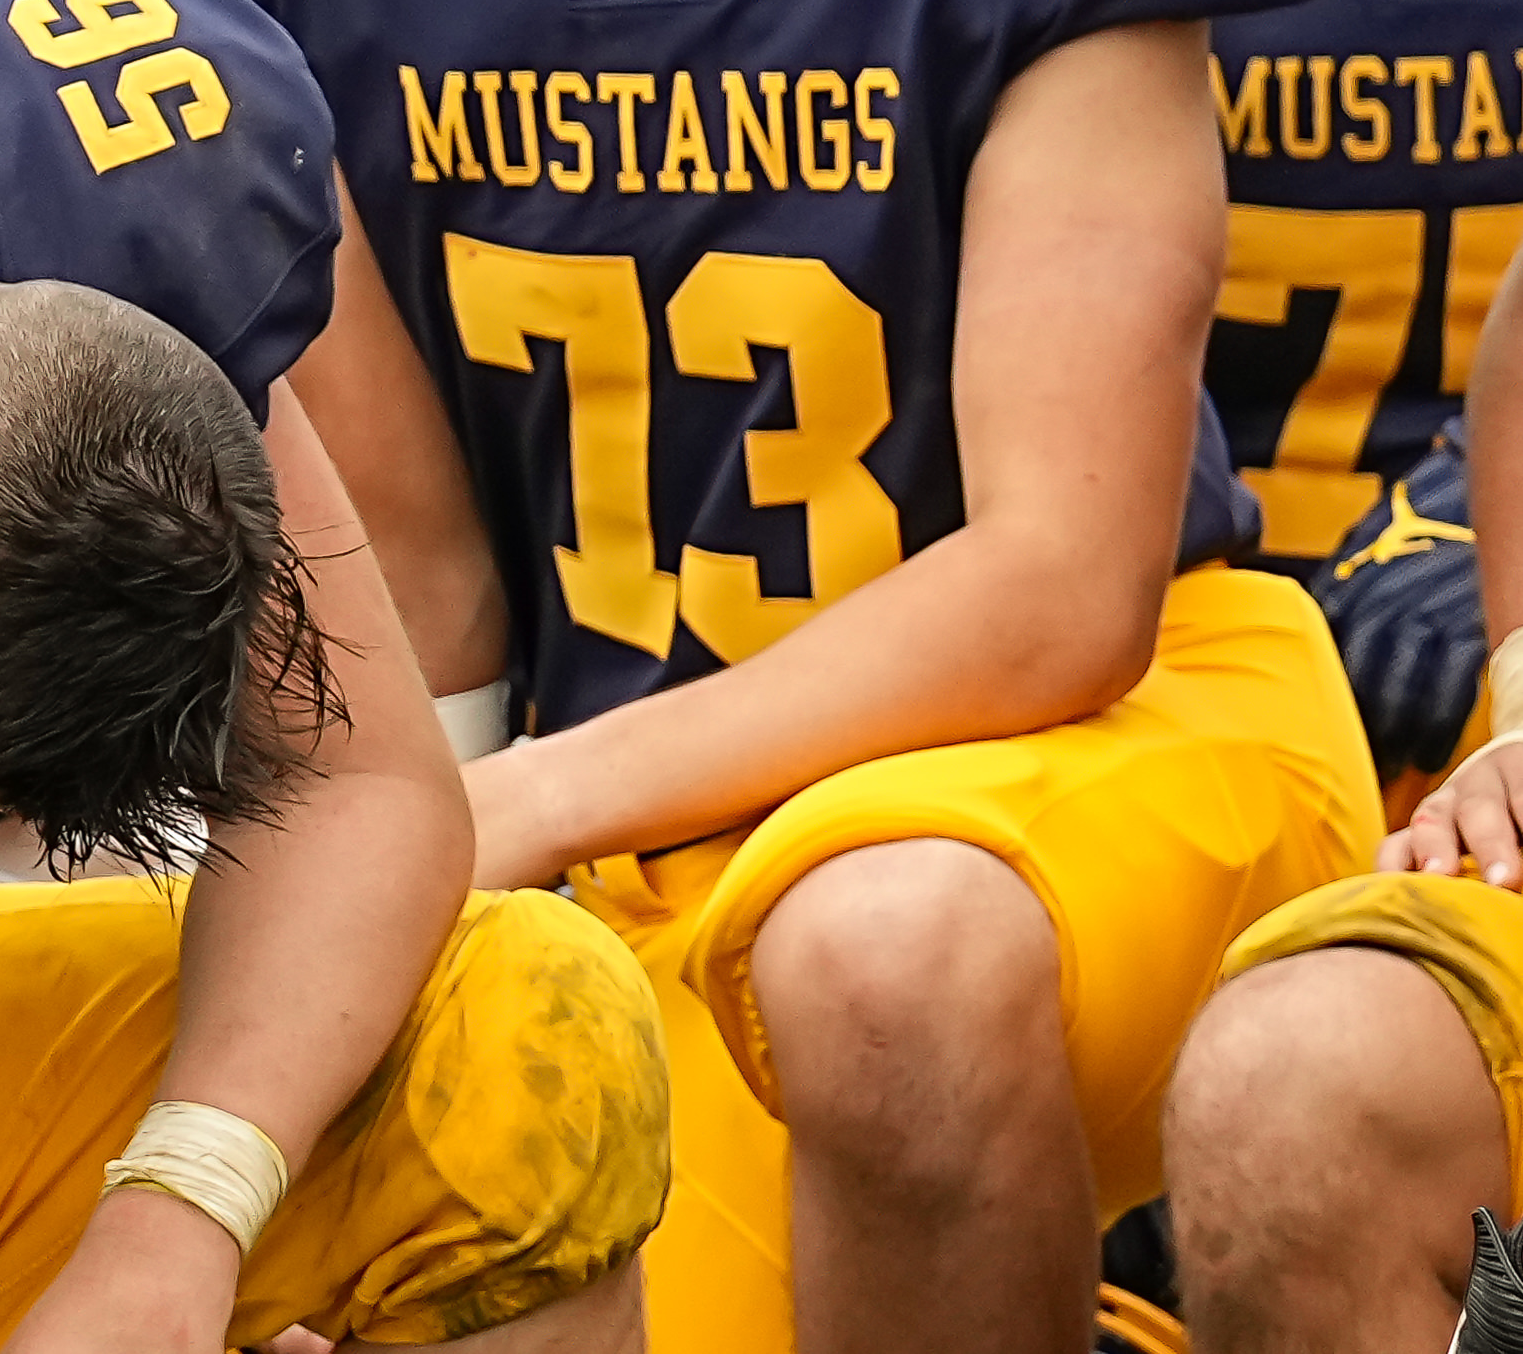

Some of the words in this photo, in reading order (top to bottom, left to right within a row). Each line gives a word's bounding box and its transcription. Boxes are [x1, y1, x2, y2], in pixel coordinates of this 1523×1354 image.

[399, 64, 900, 195] MUSTANGS
[1208, 50, 1523, 164] MUSTA
[443, 231, 902, 666] 73
